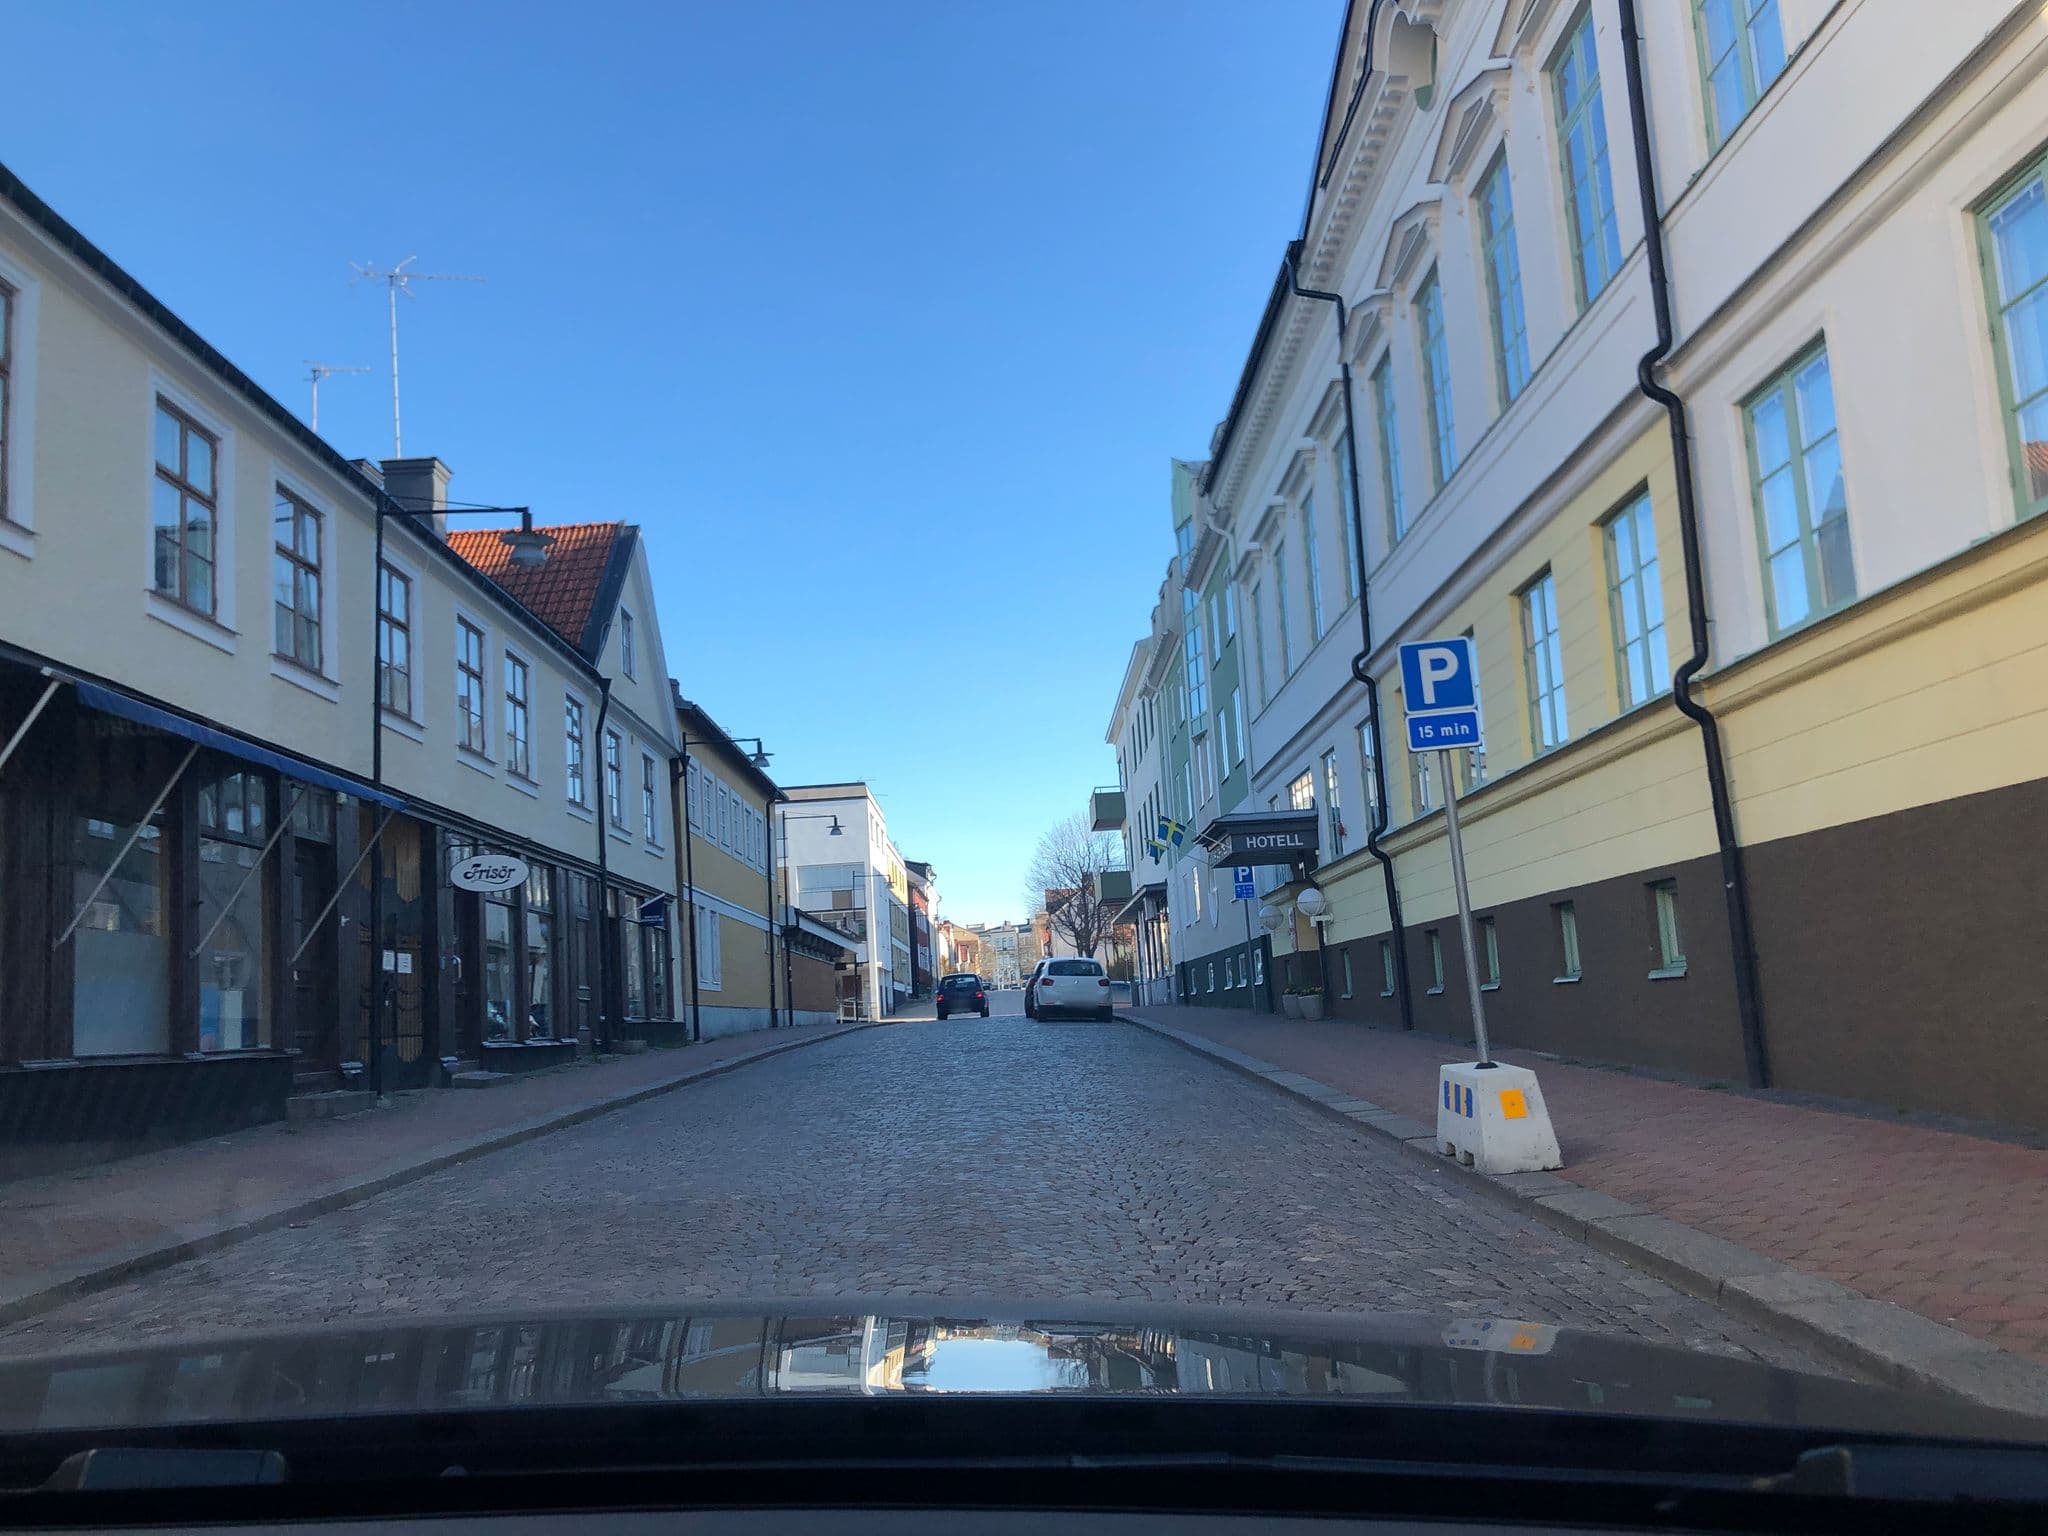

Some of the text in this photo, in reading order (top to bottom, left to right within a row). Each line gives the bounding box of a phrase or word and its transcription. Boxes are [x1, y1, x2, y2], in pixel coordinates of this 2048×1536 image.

[1417, 647, 1459, 704] P
[1418, 723, 1470, 739] 15 min
[1246, 833, 1304, 849] HOTELL
[463, 863, 516, 881] Frisör
[1237, 866, 1250, 882] P
